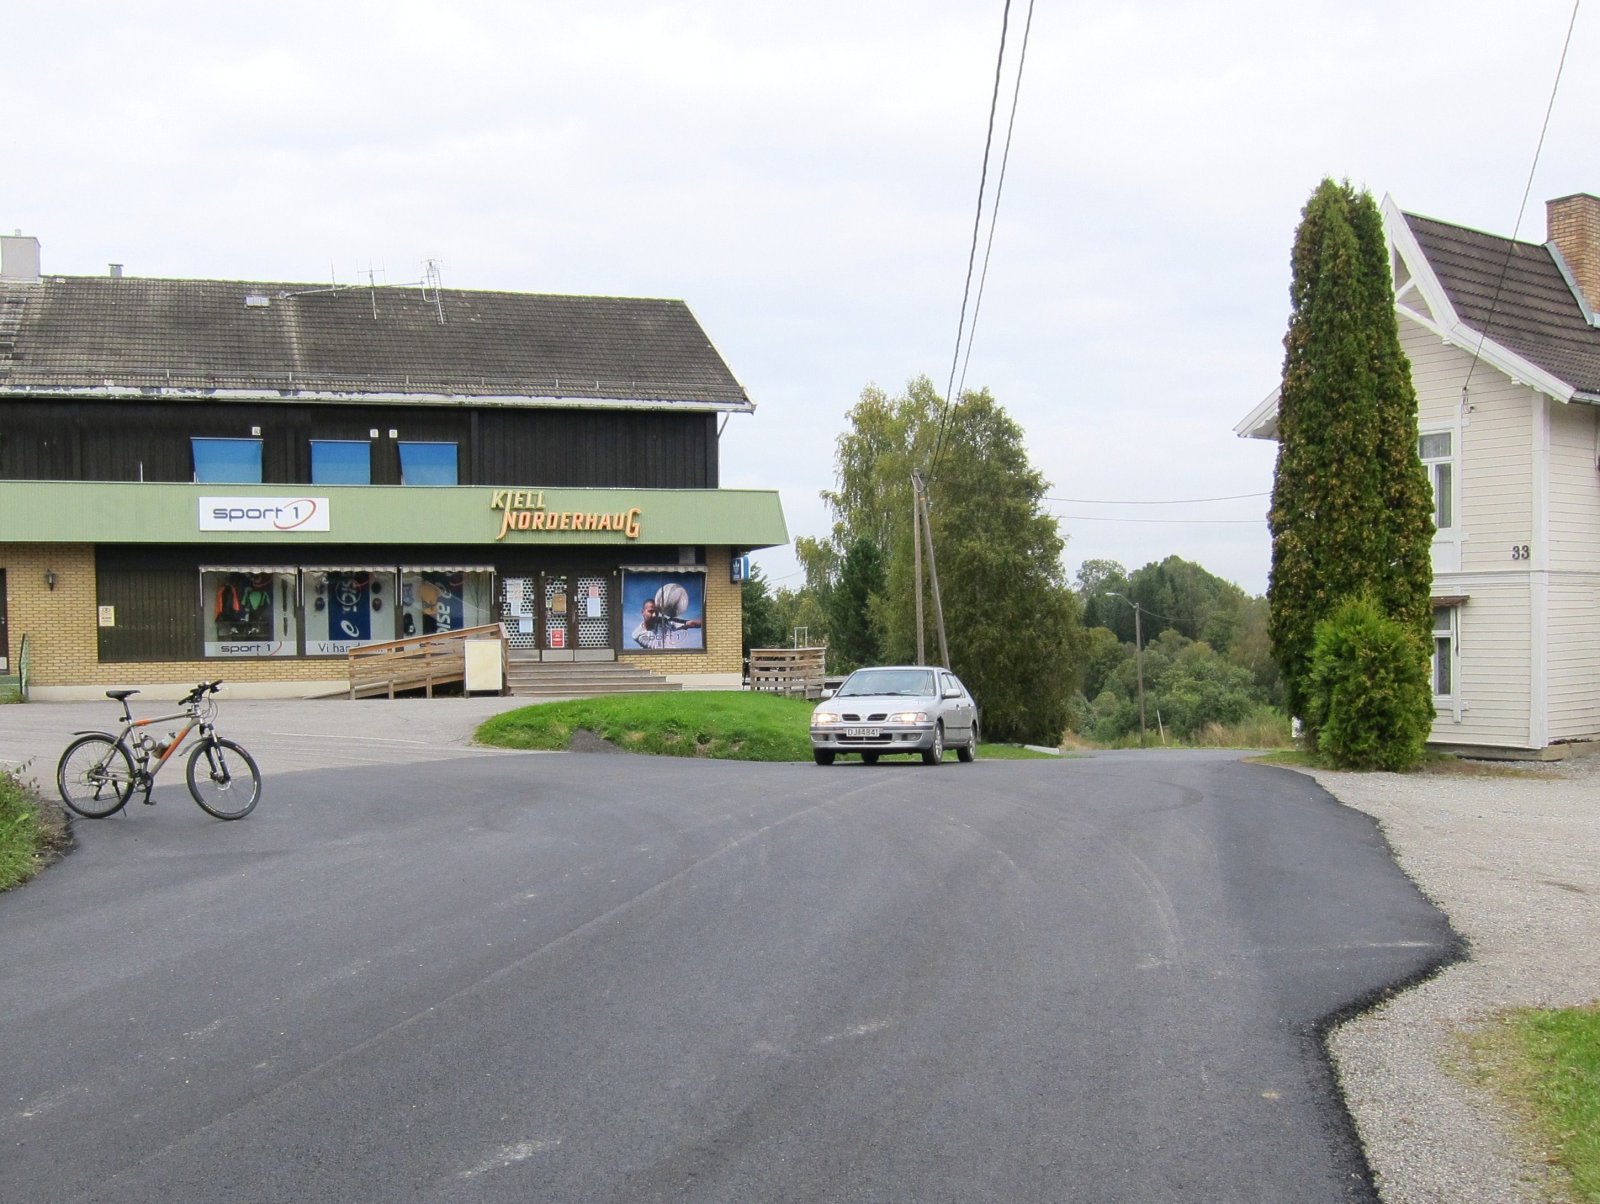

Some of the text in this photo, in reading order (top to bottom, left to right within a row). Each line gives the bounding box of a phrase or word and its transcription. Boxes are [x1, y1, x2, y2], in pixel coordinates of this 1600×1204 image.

[490, 489, 547, 511] KJELL
[212, 506, 299, 523] sport 1
[496, 507, 641, 541] NORDERHAUG
[1511, 544, 1530, 560] 33
[220, 643, 261, 654] sport
[317, 642, 330, 653] Vi
